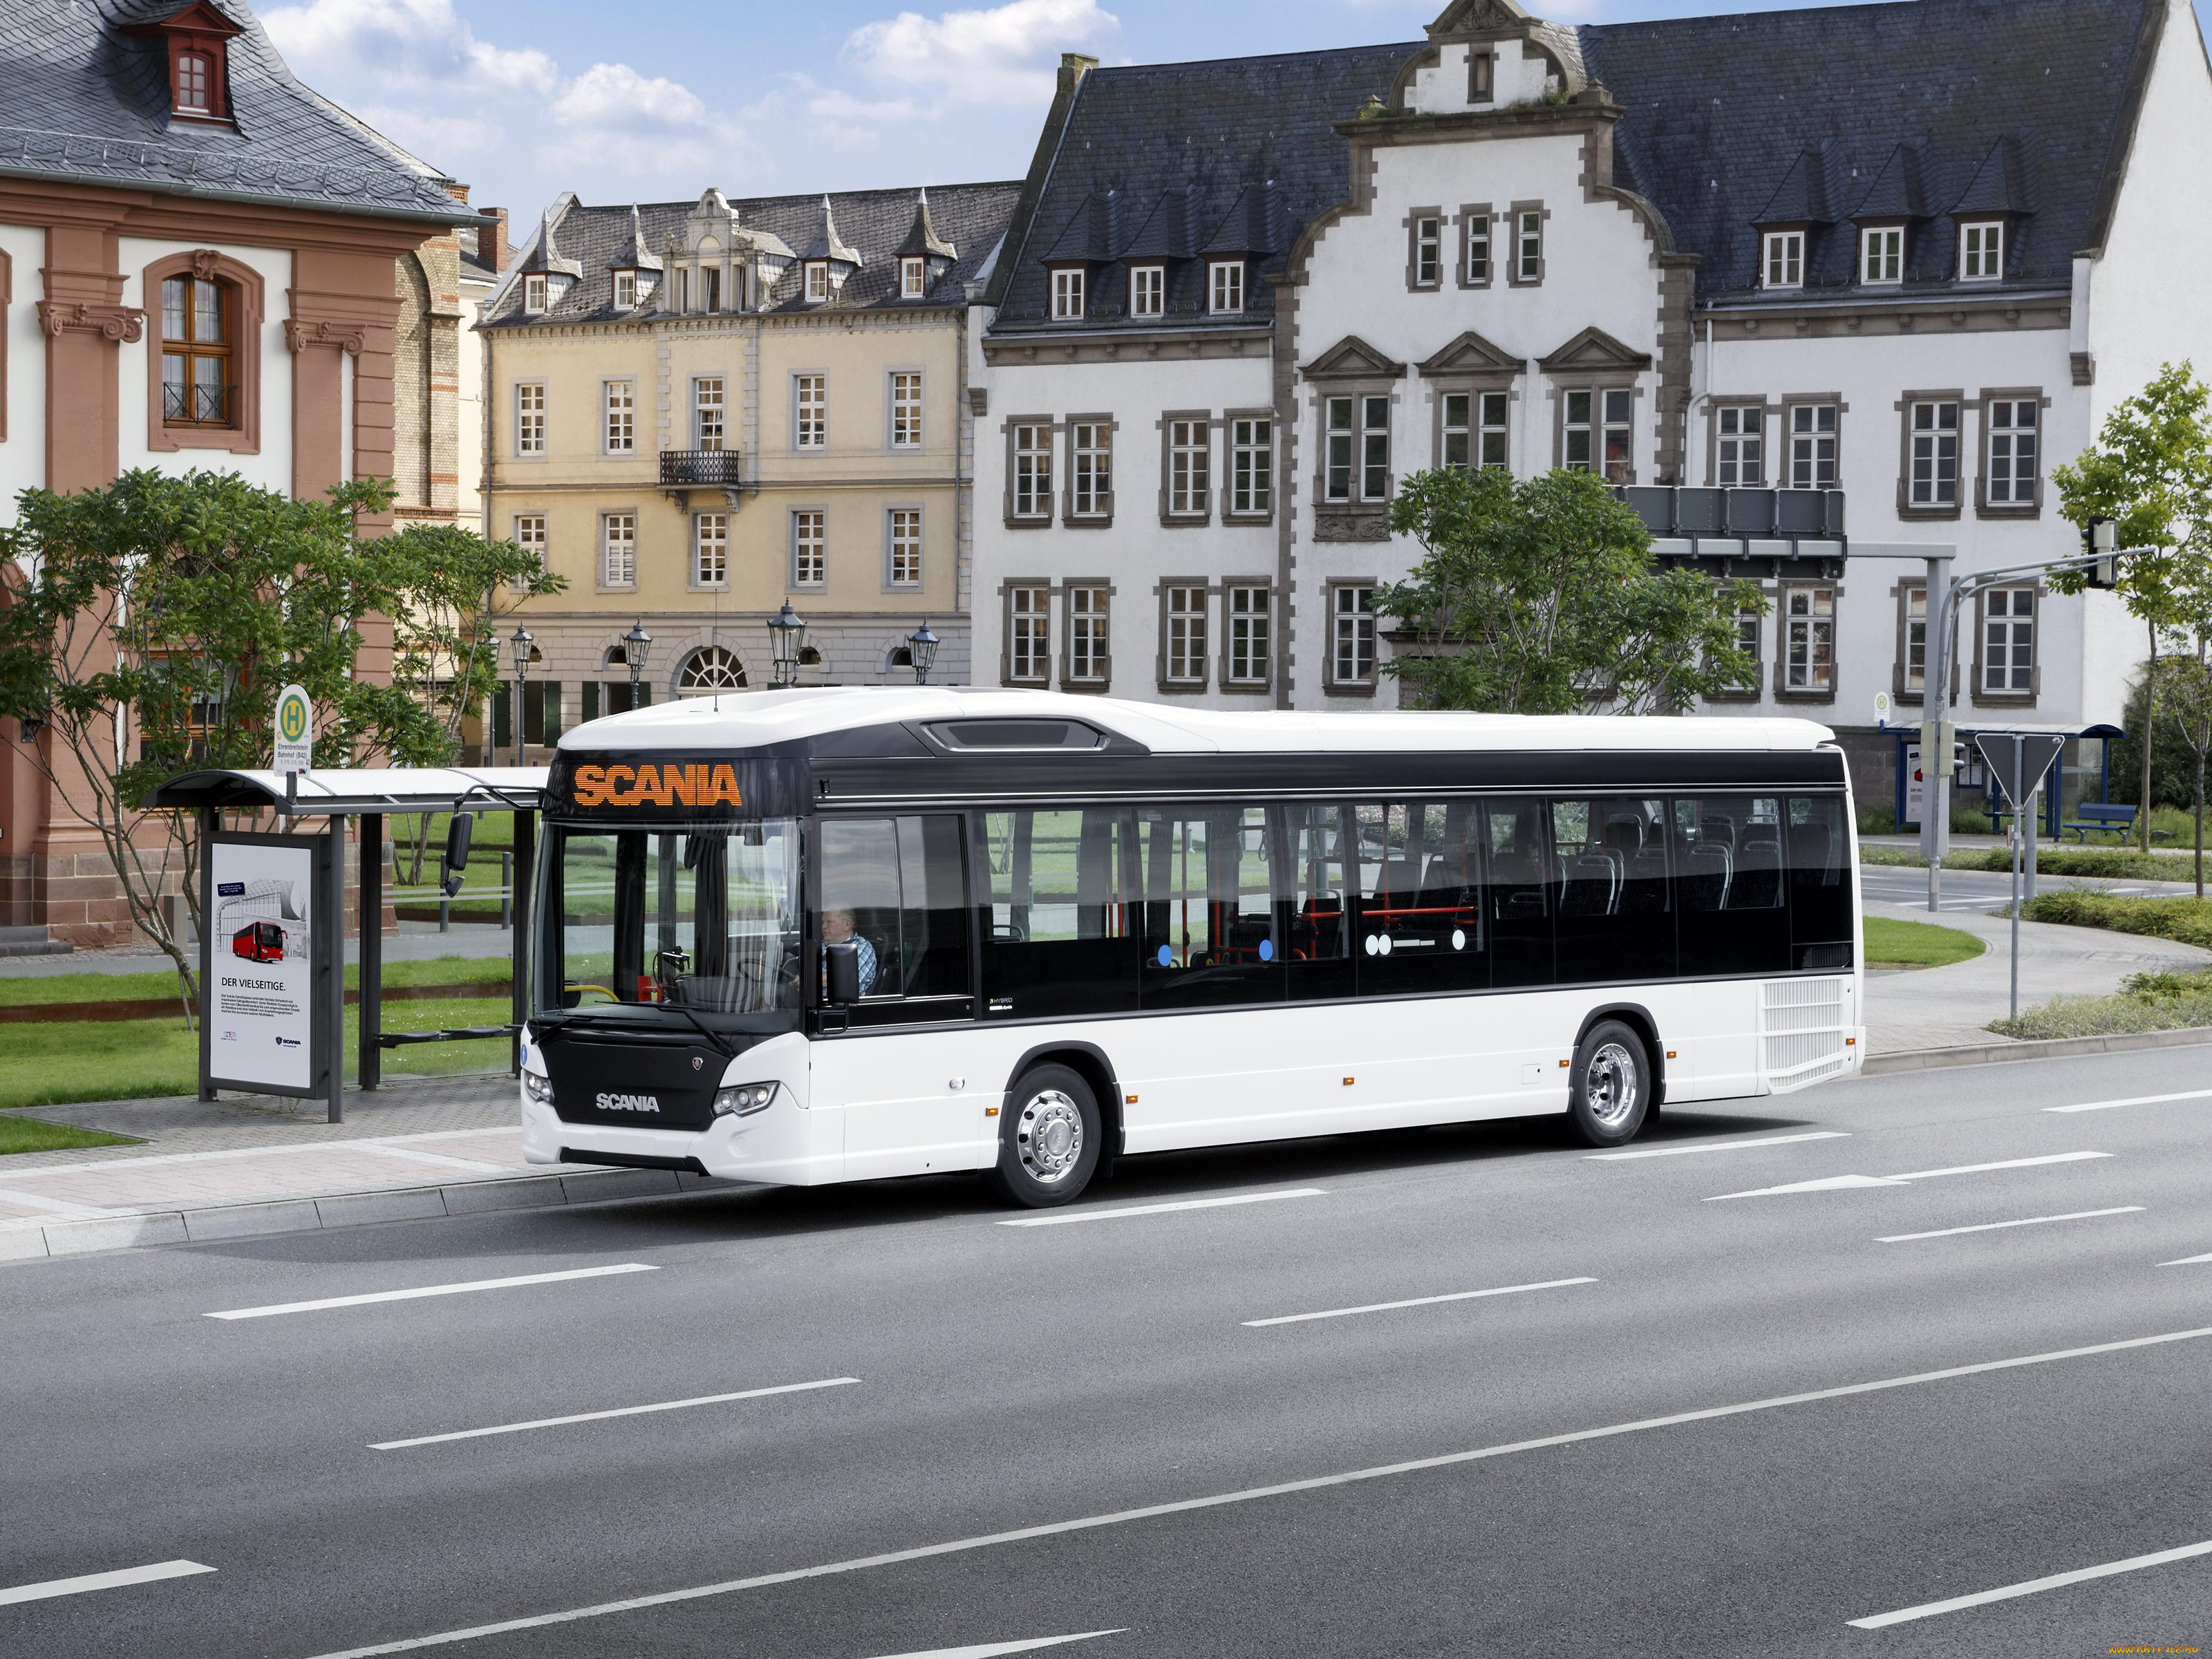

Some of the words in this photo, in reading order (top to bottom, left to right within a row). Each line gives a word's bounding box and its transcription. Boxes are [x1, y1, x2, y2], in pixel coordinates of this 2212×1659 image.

[287, 706, 299, 731] H
[574, 765, 742, 806] SCANIA
[222, 977, 237, 986] DER
[239, 979, 285, 991] VIELSEITIGE.
[596, 1093, 659, 1112] SCANIA
